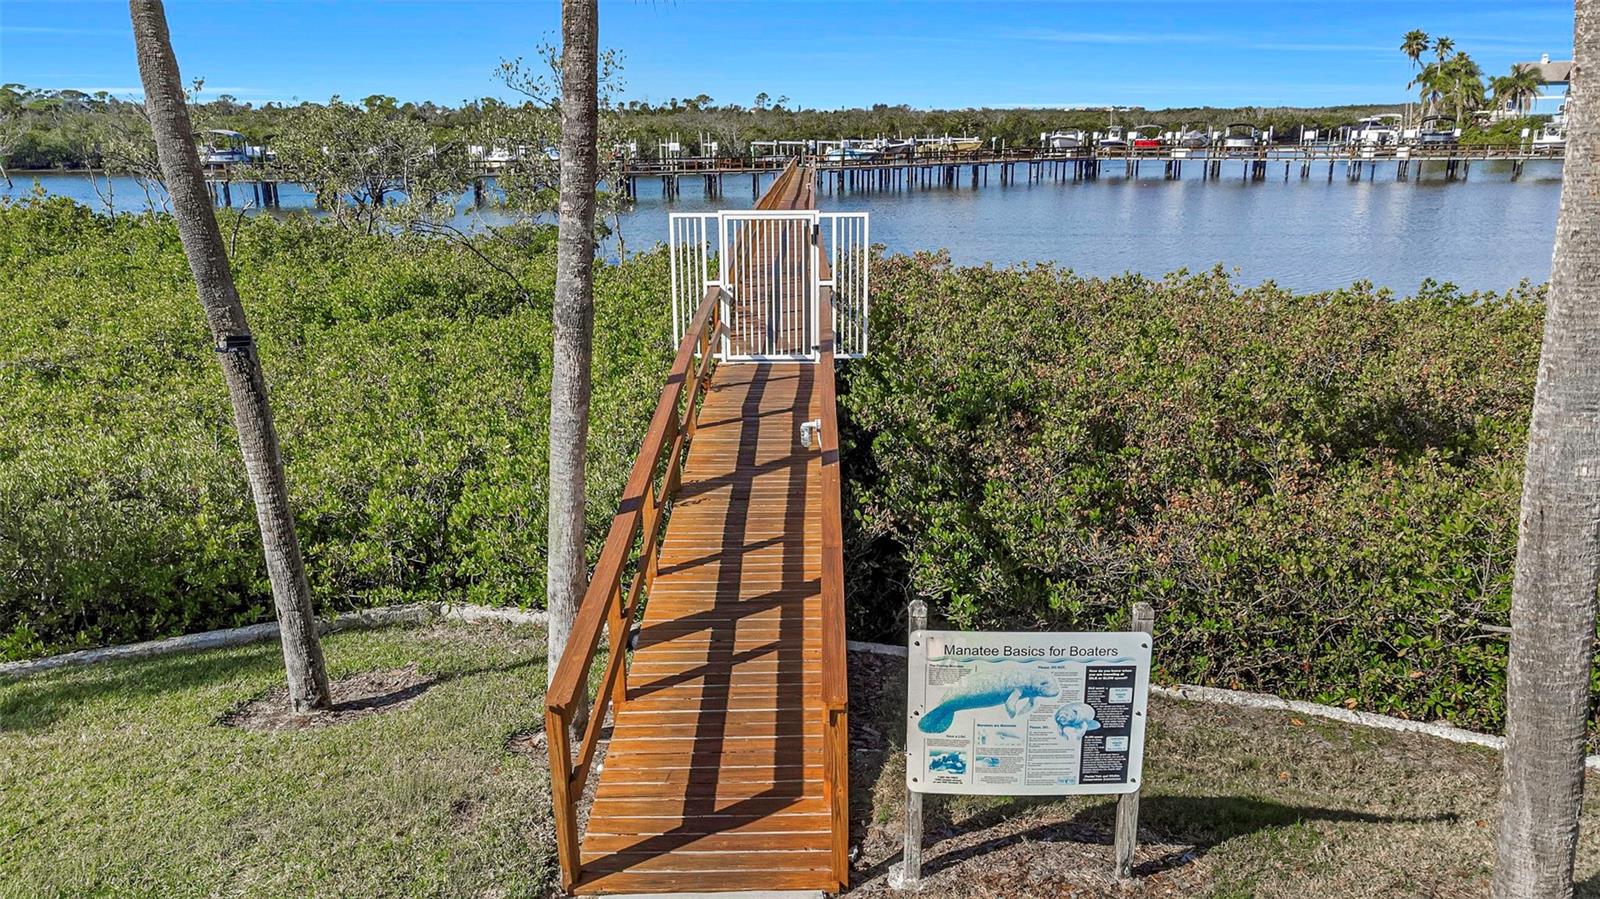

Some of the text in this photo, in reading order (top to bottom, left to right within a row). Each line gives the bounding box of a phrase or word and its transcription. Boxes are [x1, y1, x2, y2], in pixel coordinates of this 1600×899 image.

[944, 644, 1118, 657] Manatee Basics for Boaters
